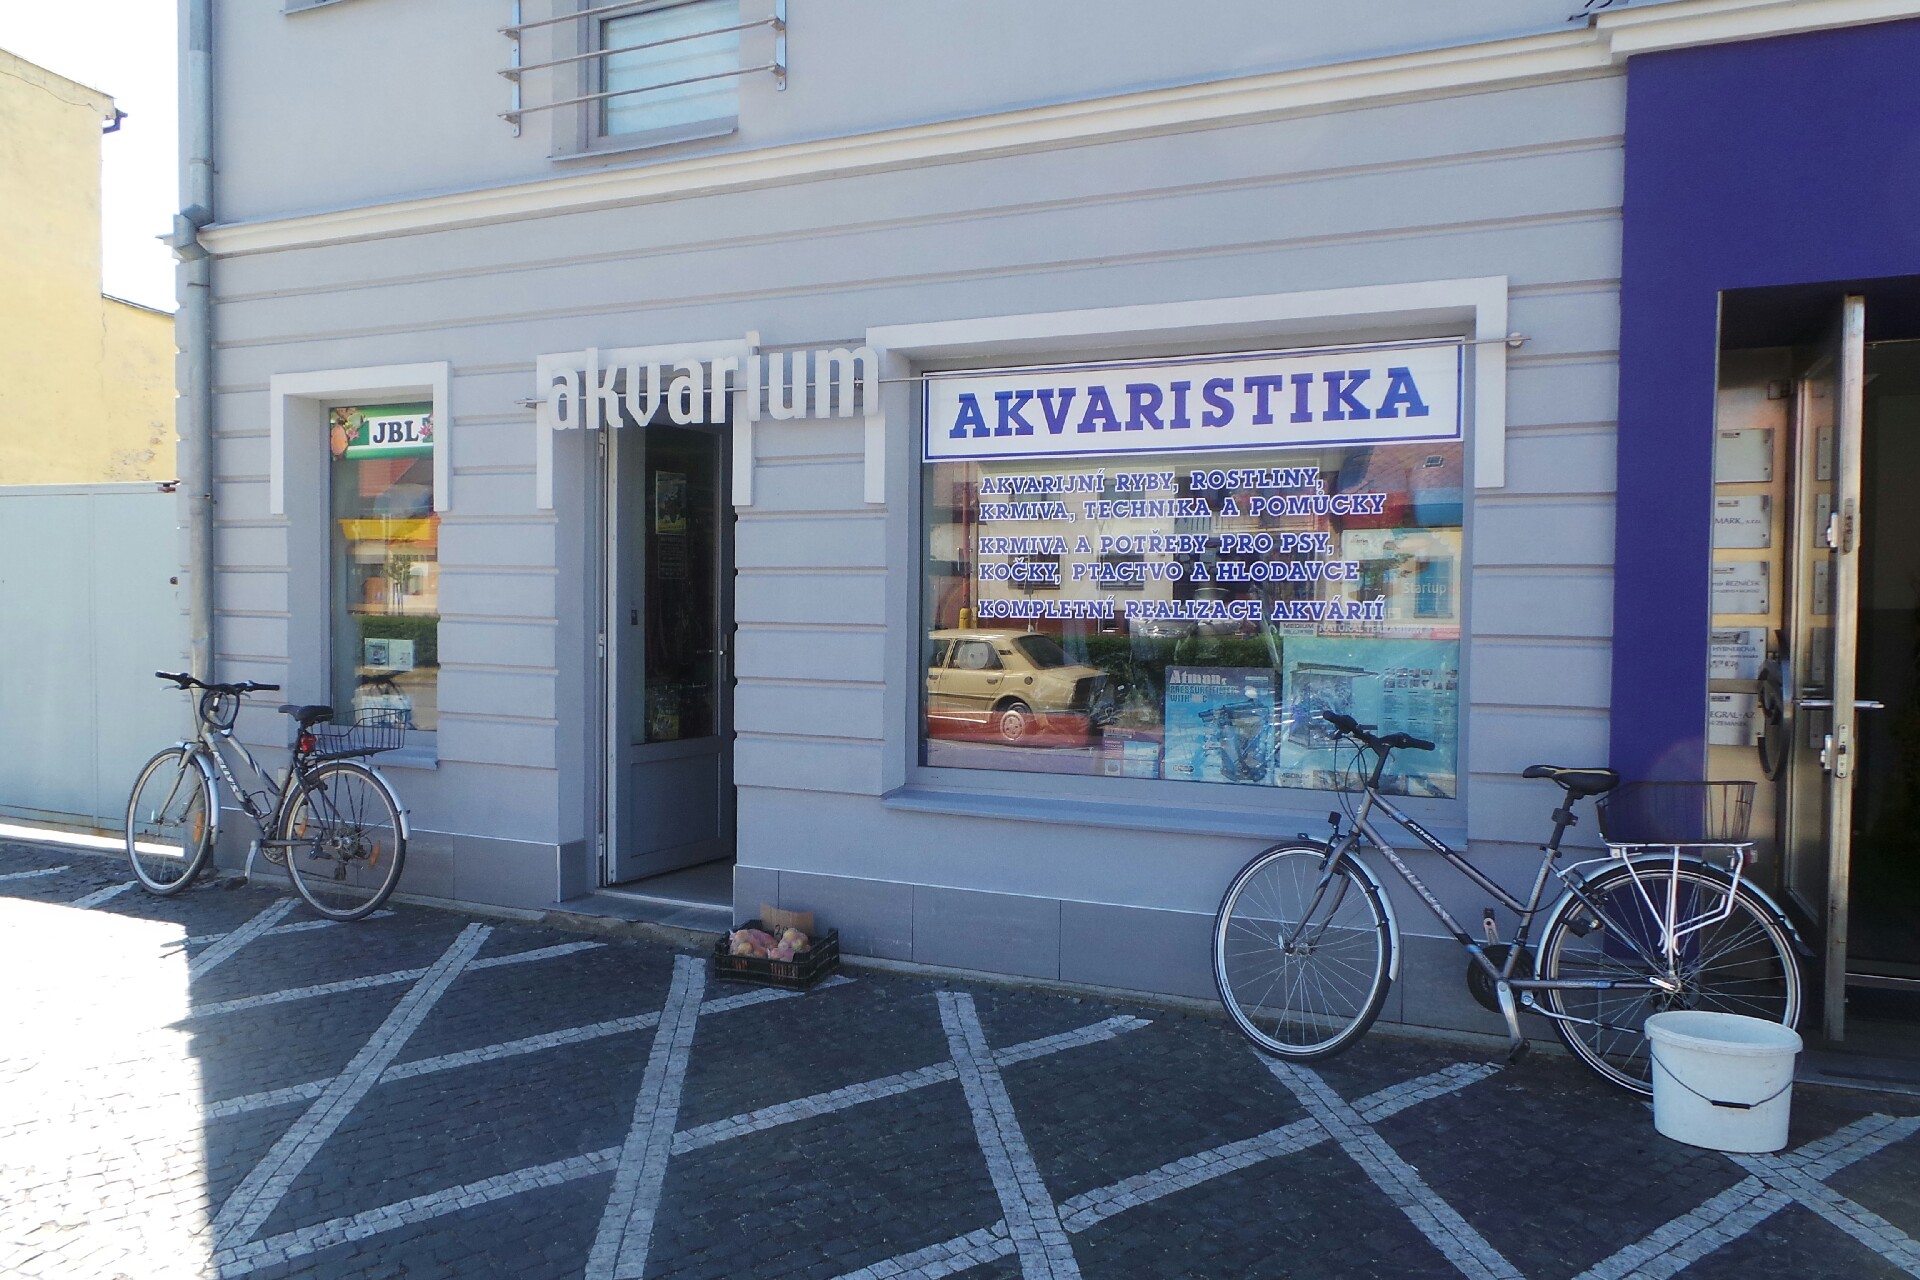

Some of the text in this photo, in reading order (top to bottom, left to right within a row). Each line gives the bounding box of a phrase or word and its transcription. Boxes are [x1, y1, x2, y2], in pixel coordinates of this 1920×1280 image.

[550, 331, 879, 430] akvarium
[949, 366, 1429, 439] AKVARISTIKA
[372, 420, 419, 443] JBL
[980, 467, 1324, 495] AKVARIJNÍ RYBY, ROSTLINY,
[979, 489, 1387, 523] KRMIVA, TECHNIKA A POMŮCKY
[979, 529, 1335, 555] KRMIVA A POTŘEBY PRO PSY,
[979, 557, 1360, 584] KOČKY, PTACTVO A HLODAVCE
[1403, 583, 1447, 597] Startup
[978, 595, 1386, 621] KOMPLETNÍ REALIZACE AKVÁRIÍ
